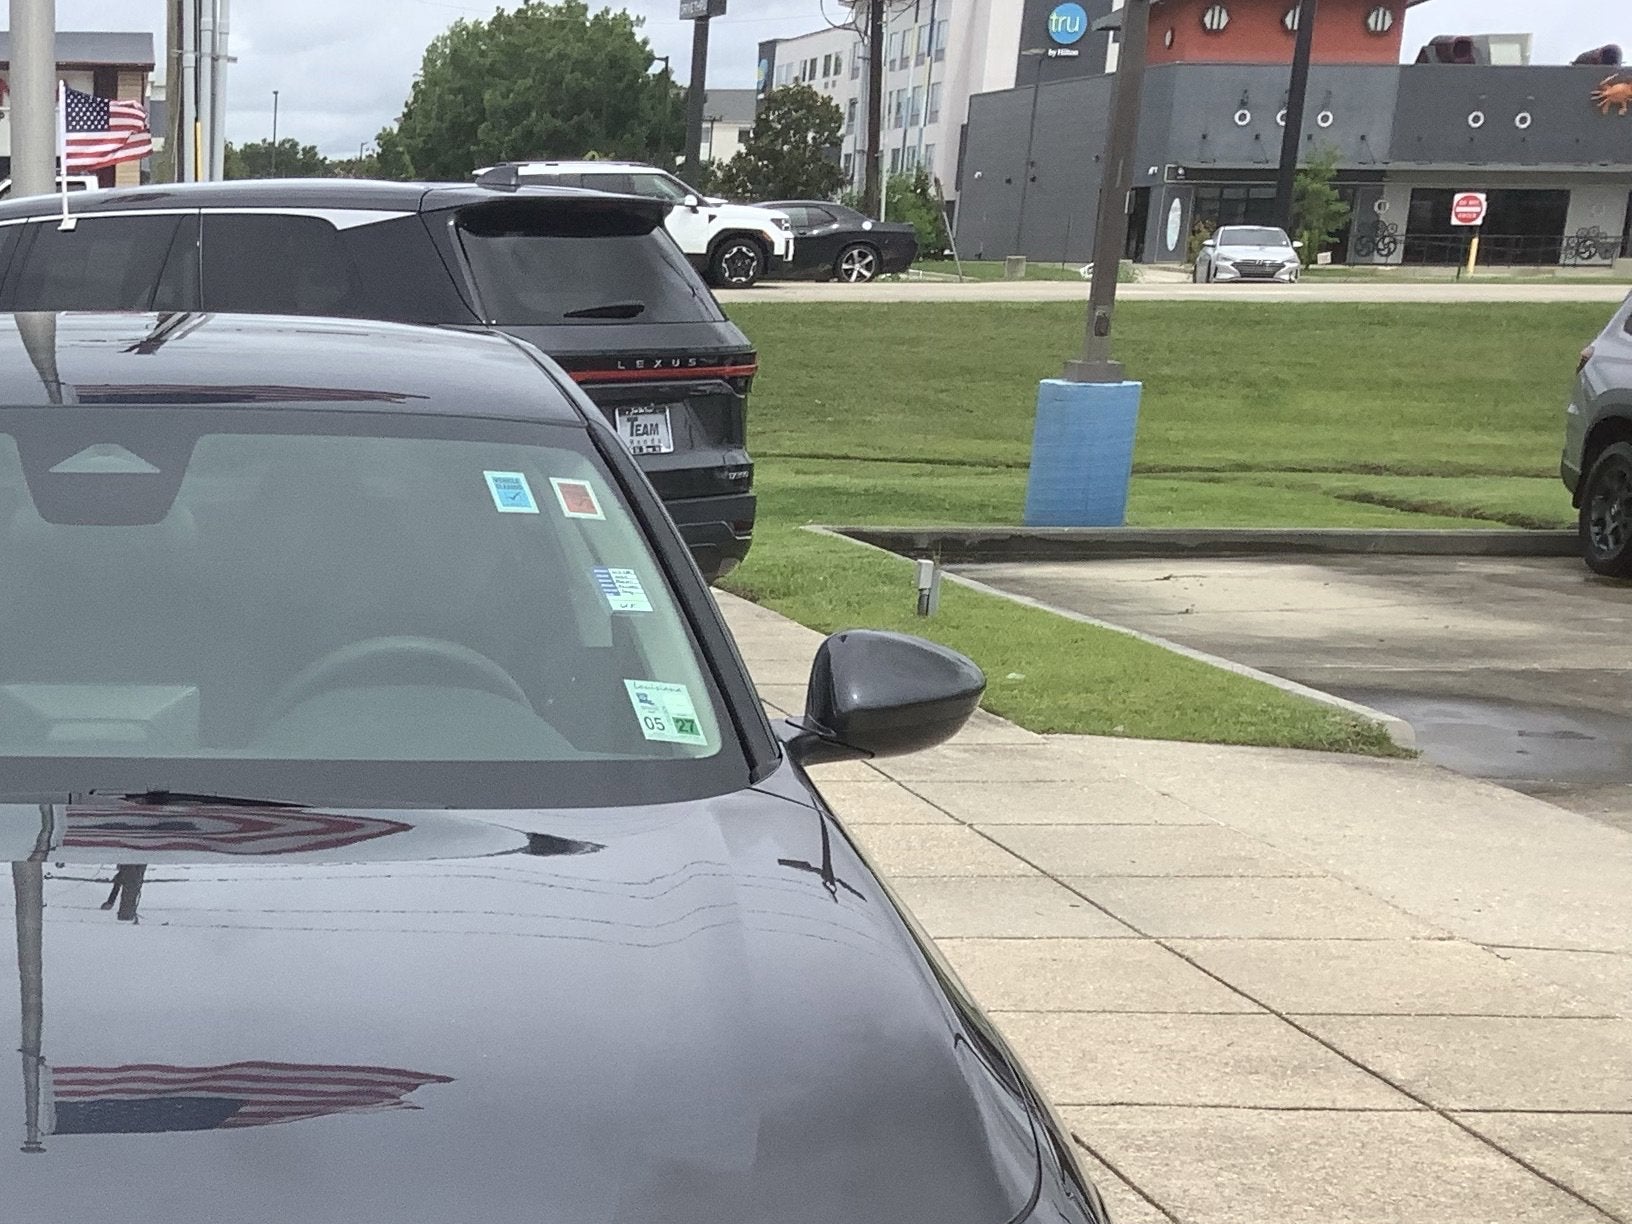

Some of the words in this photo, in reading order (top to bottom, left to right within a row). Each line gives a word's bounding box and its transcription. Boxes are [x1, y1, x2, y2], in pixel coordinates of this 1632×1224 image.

[1049, 11, 1080, 33] tru
[1048, 48, 1058, 58] by
[617, 358, 697, 370] LEXUS
[626, 416, 660, 437] TEAM
[644, 716, 665, 731] 05
[675, 718, 695, 733] 27
